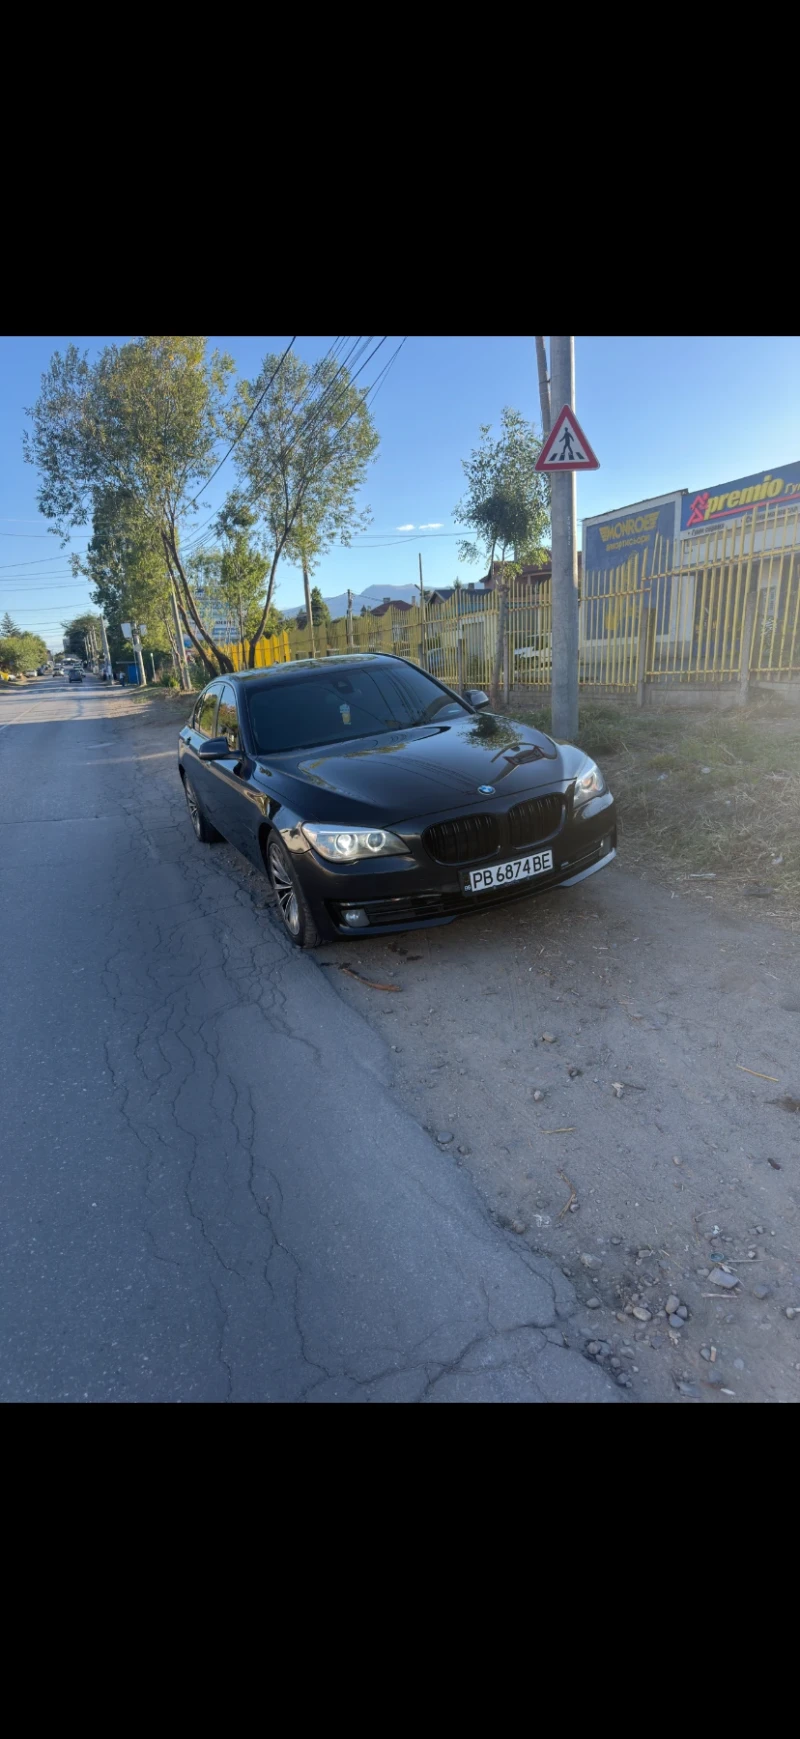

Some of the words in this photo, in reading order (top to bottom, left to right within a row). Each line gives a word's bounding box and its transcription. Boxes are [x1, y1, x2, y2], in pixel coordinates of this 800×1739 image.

[704, 474, 785, 520] premio
[472, 870, 494, 889] PB
[496, 859, 531, 882] 6874
[533, 852, 551, 872] BE
